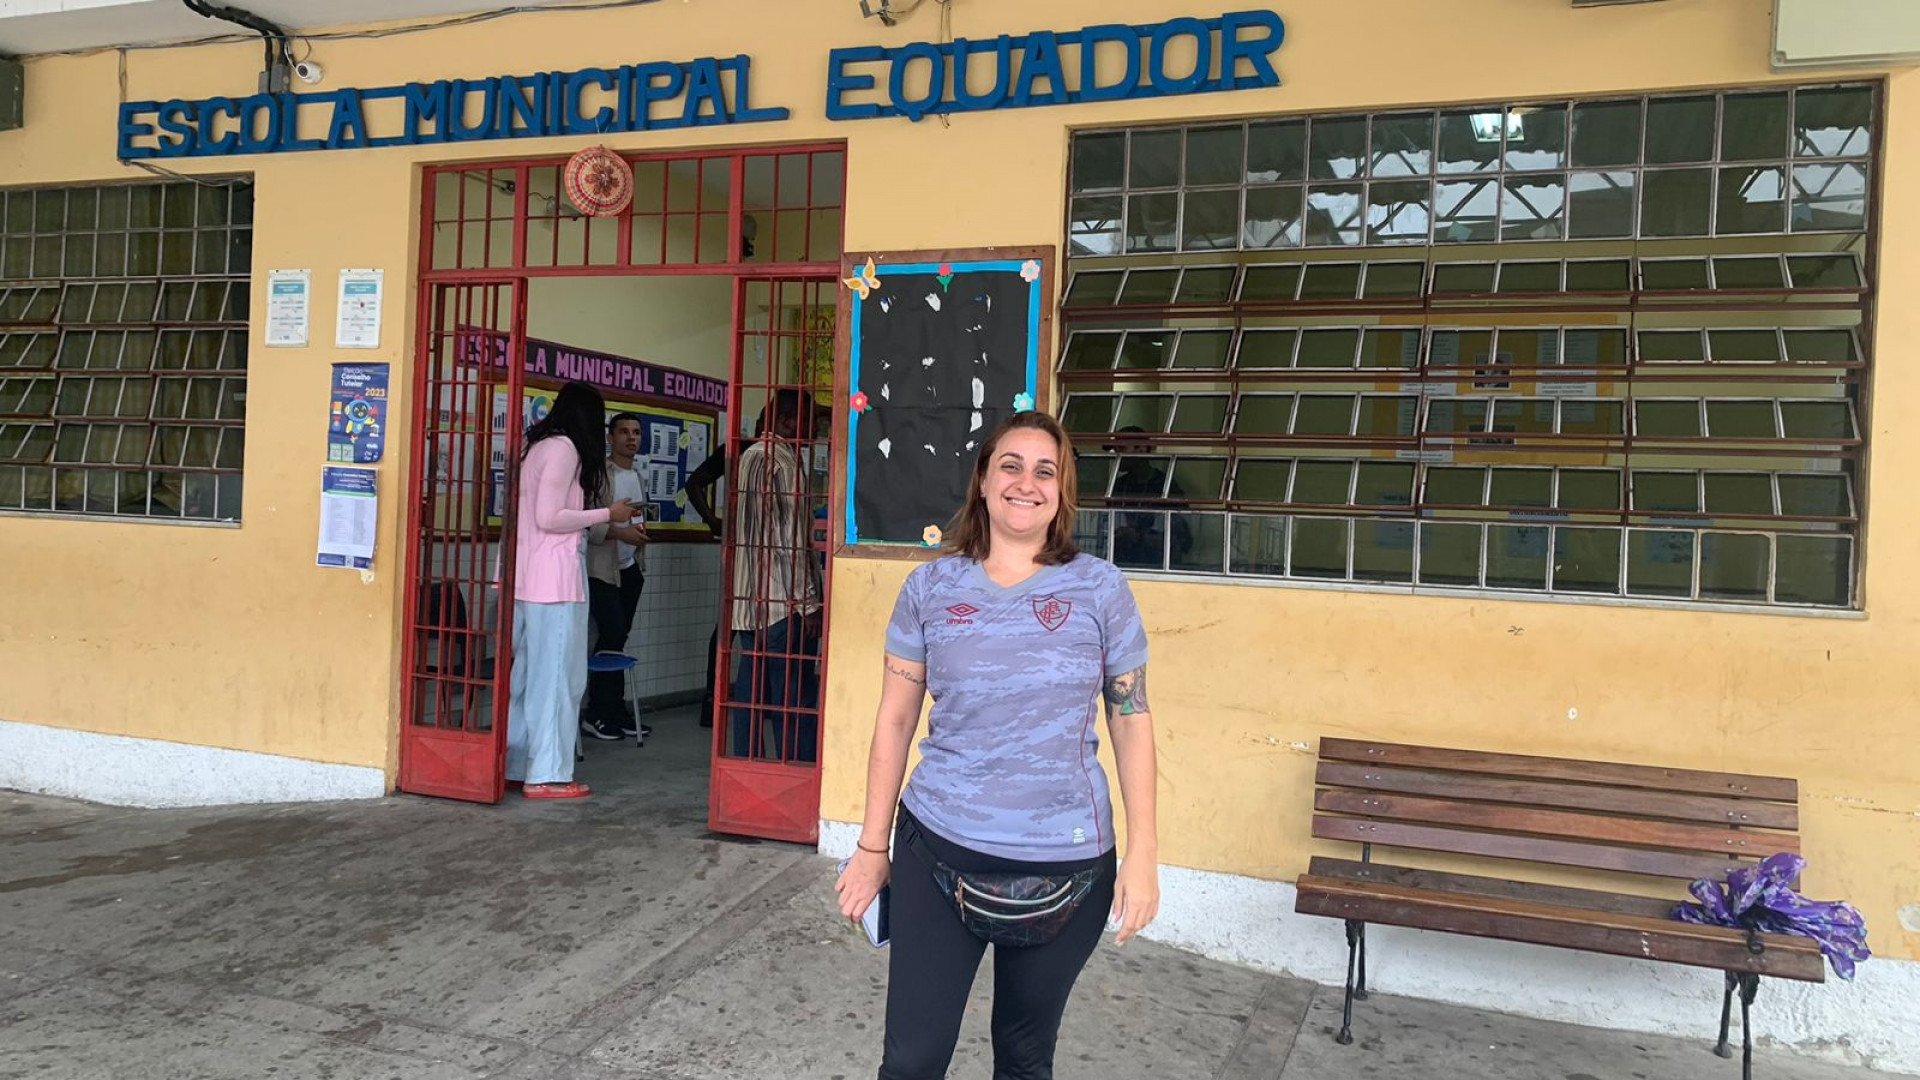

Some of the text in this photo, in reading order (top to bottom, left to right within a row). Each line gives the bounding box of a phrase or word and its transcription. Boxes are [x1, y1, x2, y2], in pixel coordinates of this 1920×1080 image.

[118, 10, 1285, 160] ESCOLA MUNICIPAL EQUADOR
[460, 335, 547, 374] ESCLA
[555, 352, 654, 392] MUNICIPAL
[341, 372, 371, 381] Conselho
[365, 387, 385, 397] 2023
[946, 617, 974, 625] umbro
